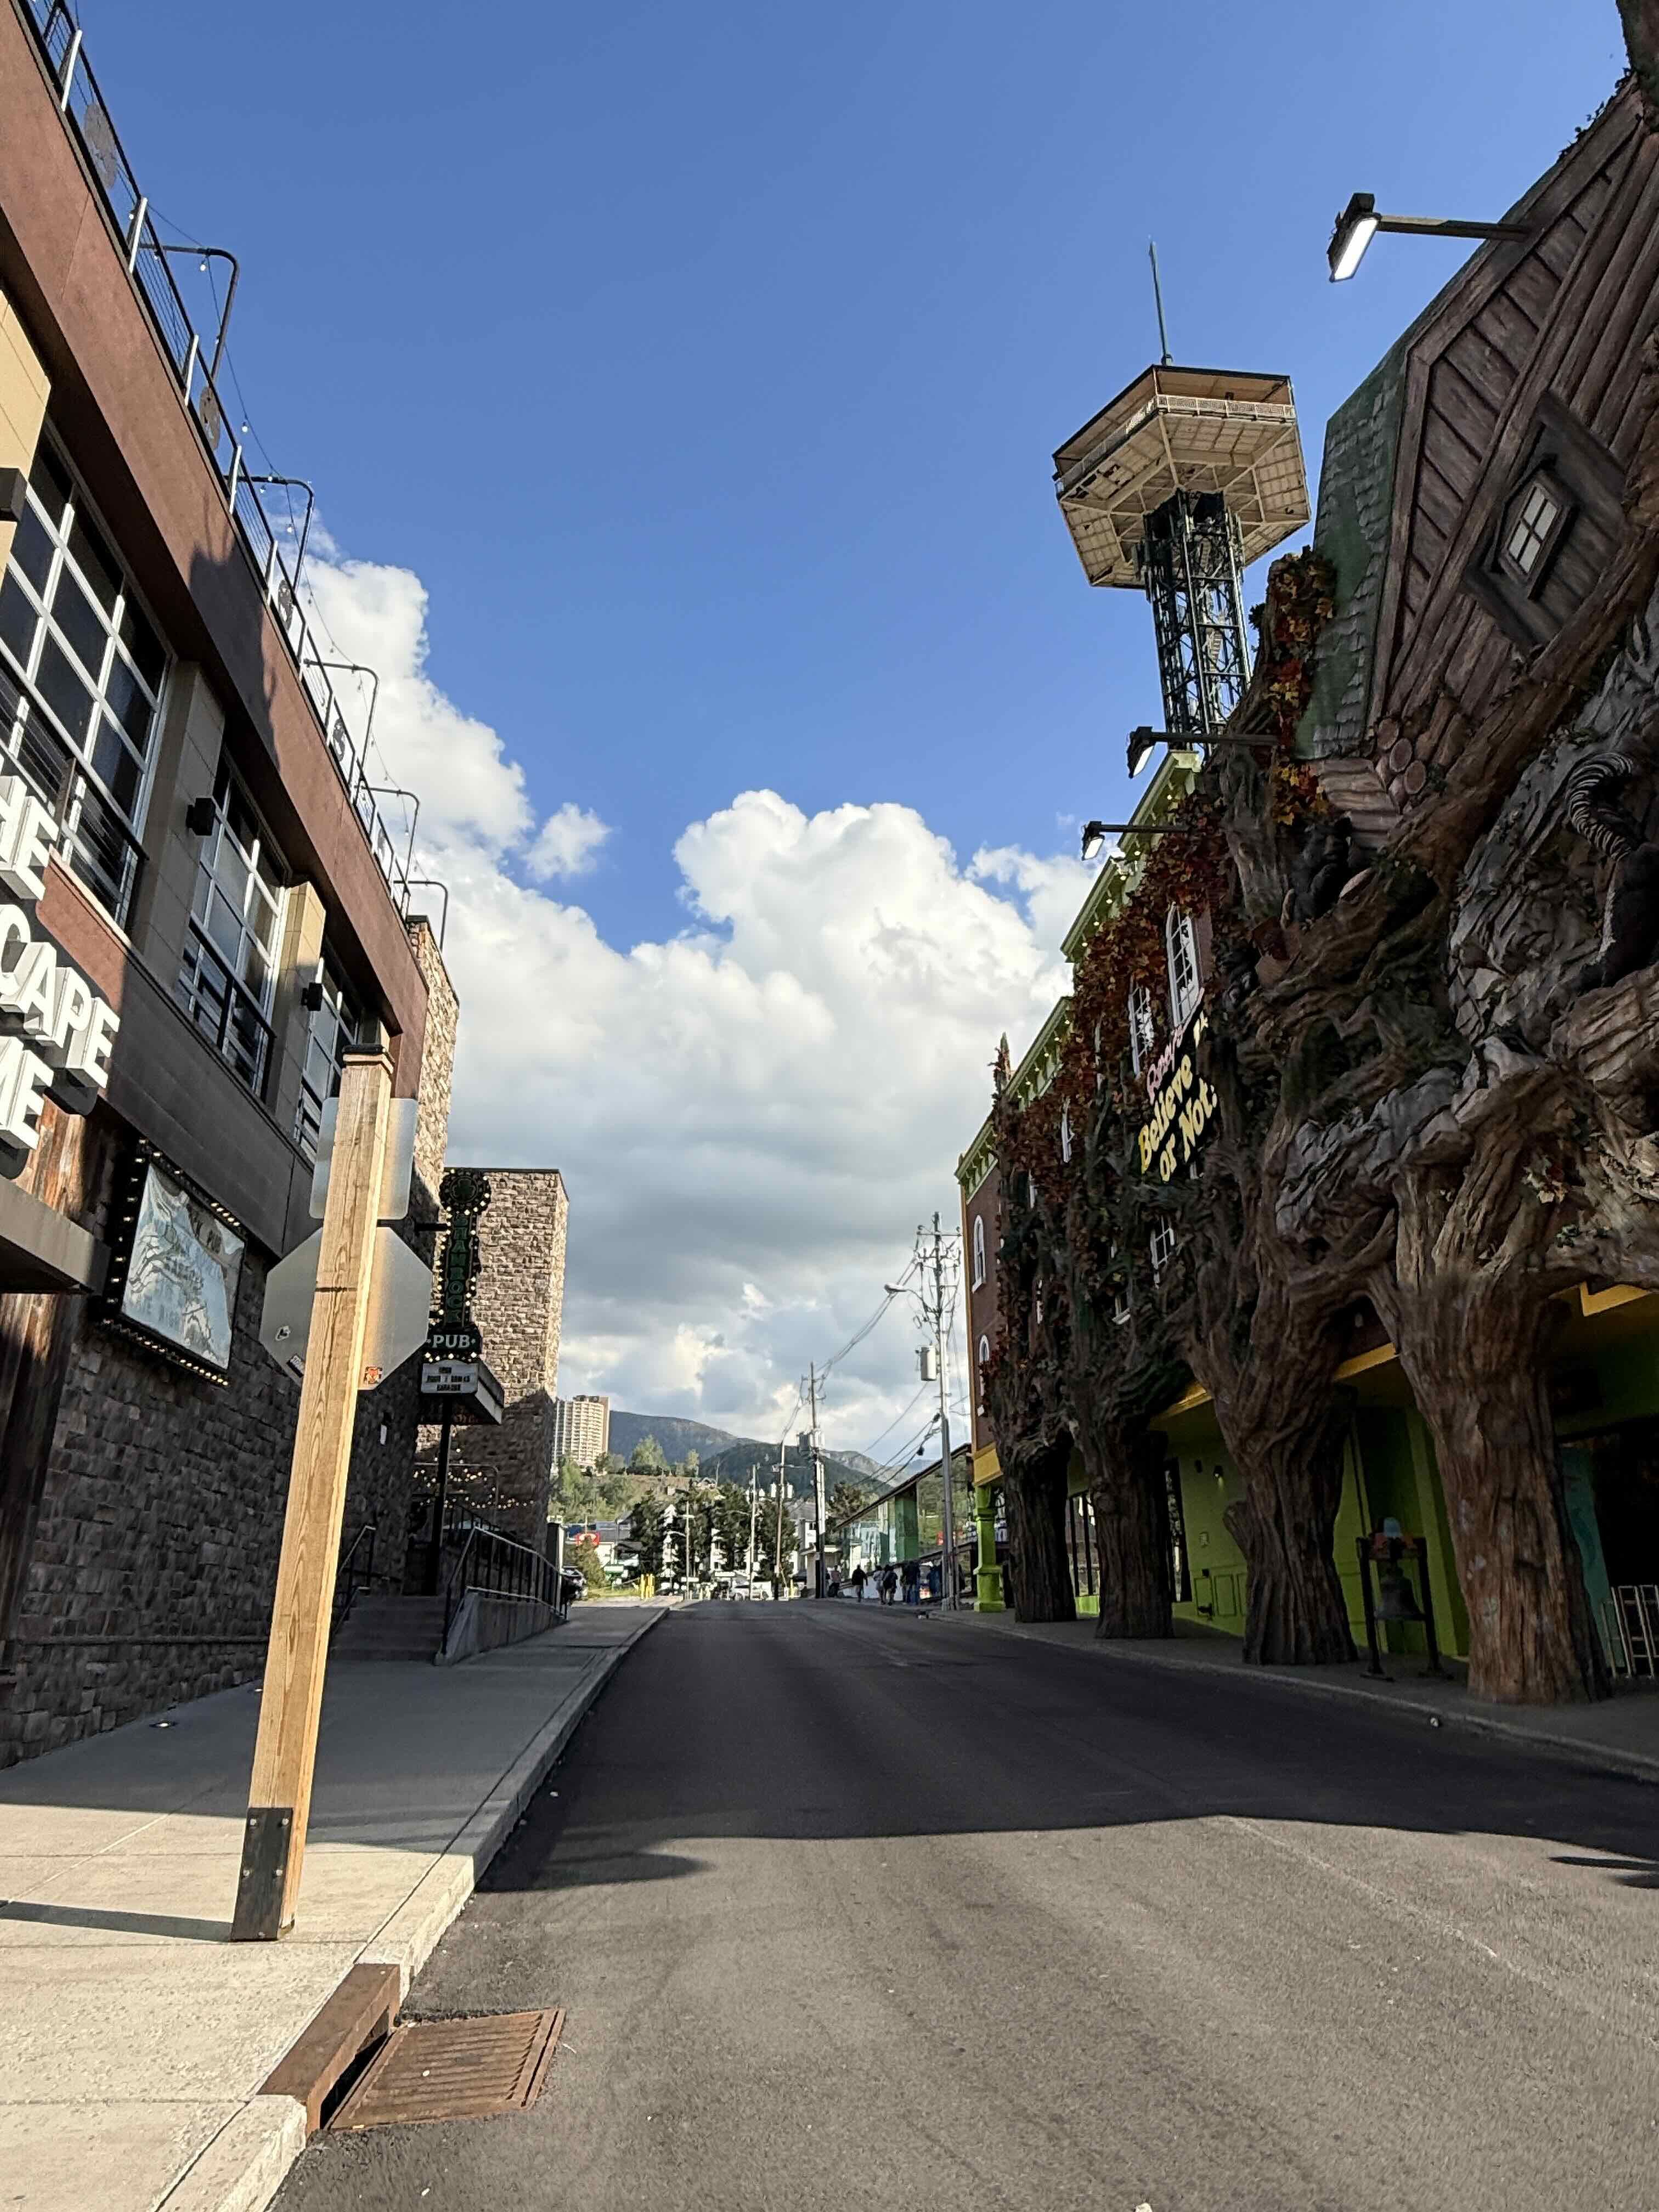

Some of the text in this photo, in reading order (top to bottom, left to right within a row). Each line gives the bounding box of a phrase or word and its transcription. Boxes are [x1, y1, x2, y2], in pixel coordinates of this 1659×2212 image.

[1138, 1054, 1193, 1175] Believe
[1160, 1133, 1177, 1182] or
[432, 1334, 470, 1348] PUB
